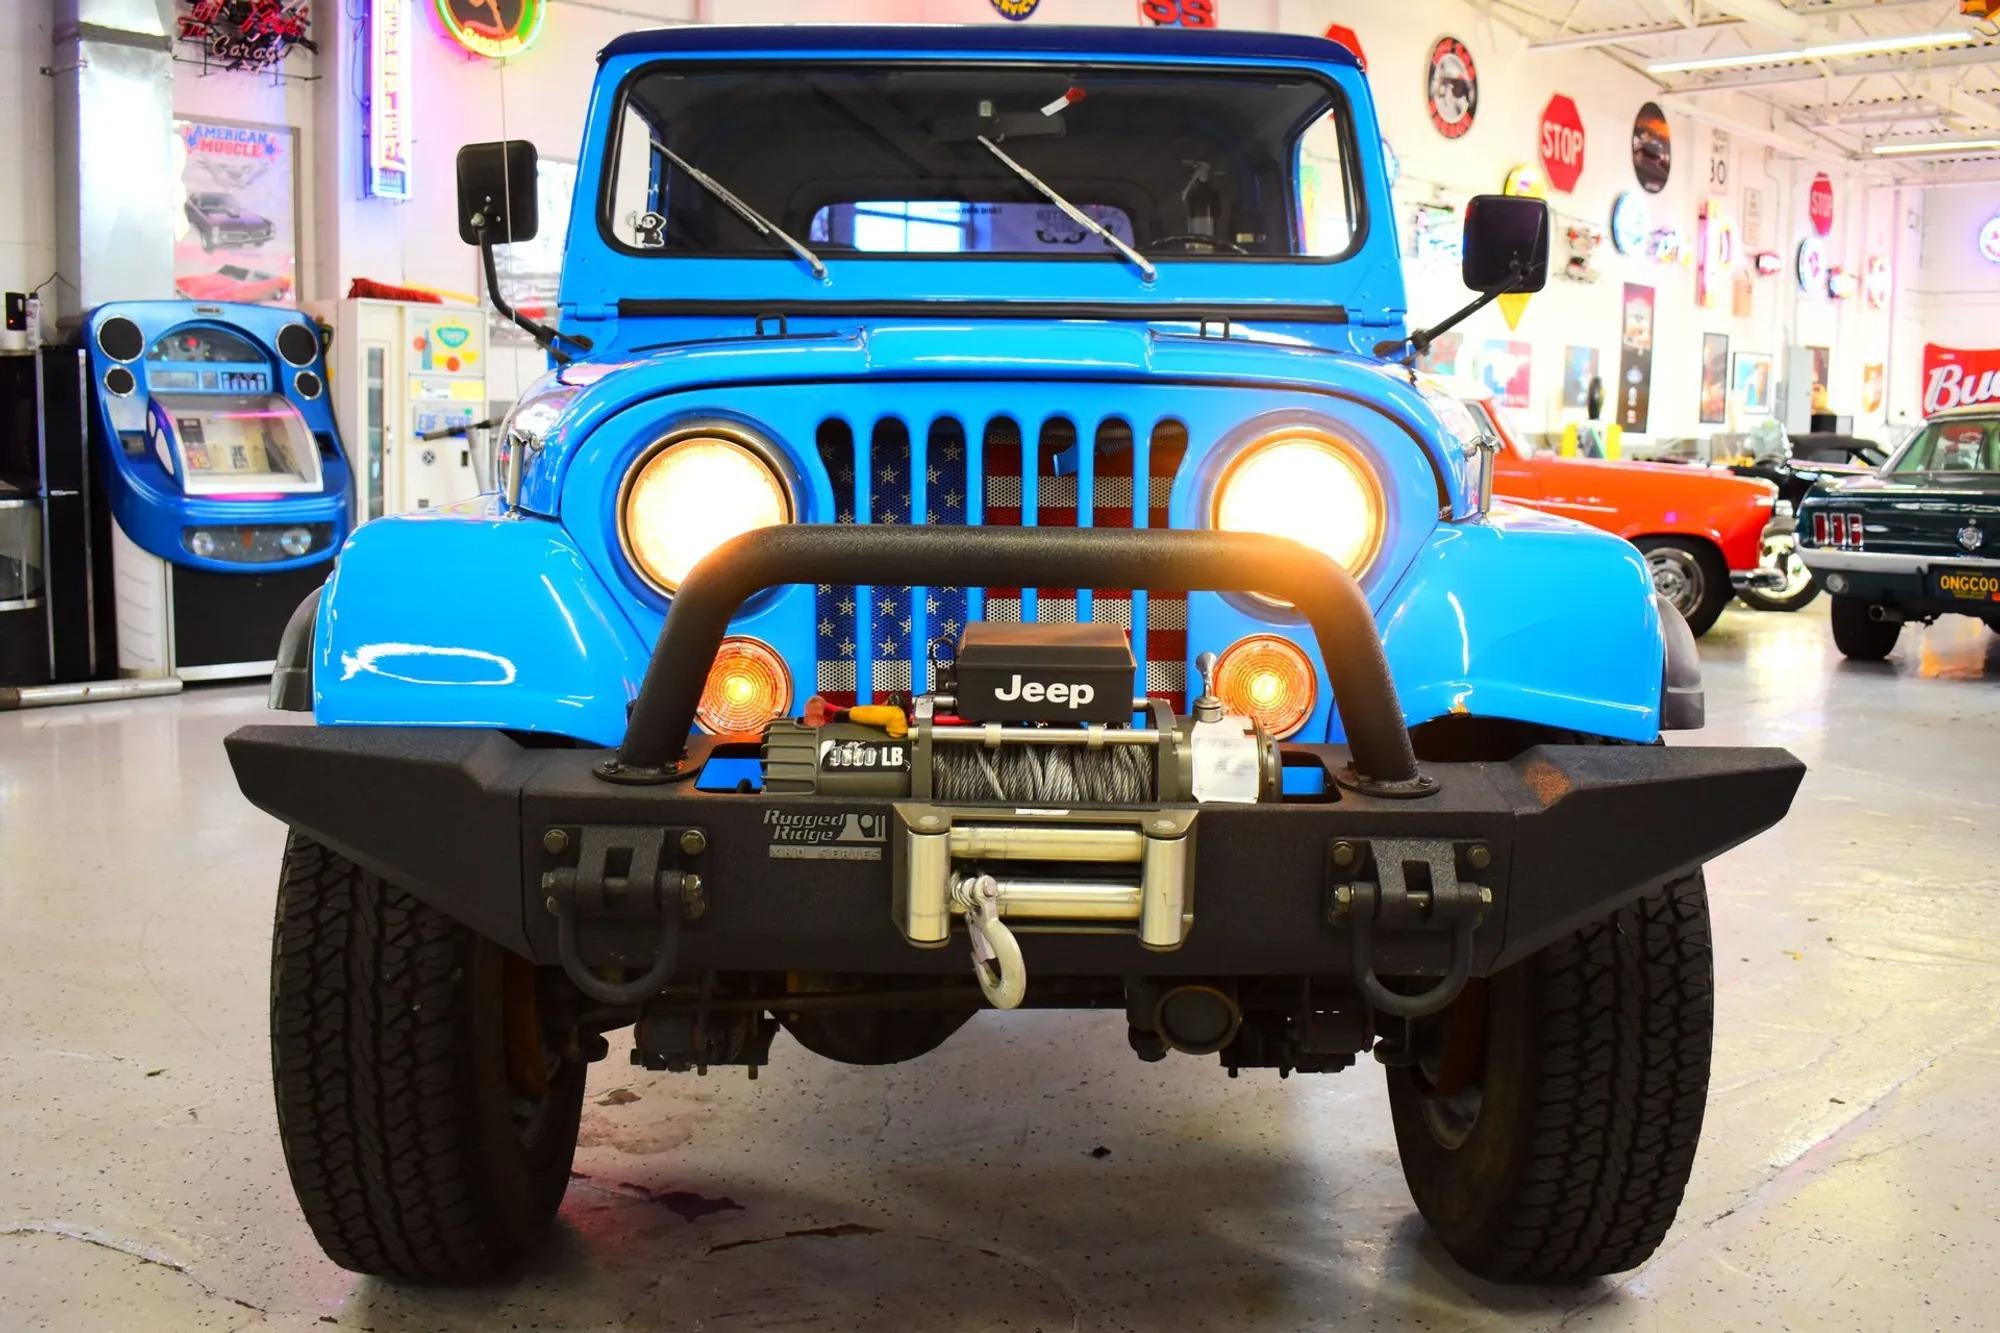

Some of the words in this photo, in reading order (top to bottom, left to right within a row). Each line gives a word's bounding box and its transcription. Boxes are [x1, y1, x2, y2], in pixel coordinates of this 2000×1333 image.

[193, 126, 268, 144] AMERICAN
[1542, 120, 1583, 166] STOP
[200, 138, 263, 157] MUSCLE
[994, 674, 1095, 710] Jeep
[881, 746, 904, 767] LB
[763, 809, 845, 829] Rugged
[773, 825, 834, 844] Ridge
[818, 847, 882, 860] SERIES
